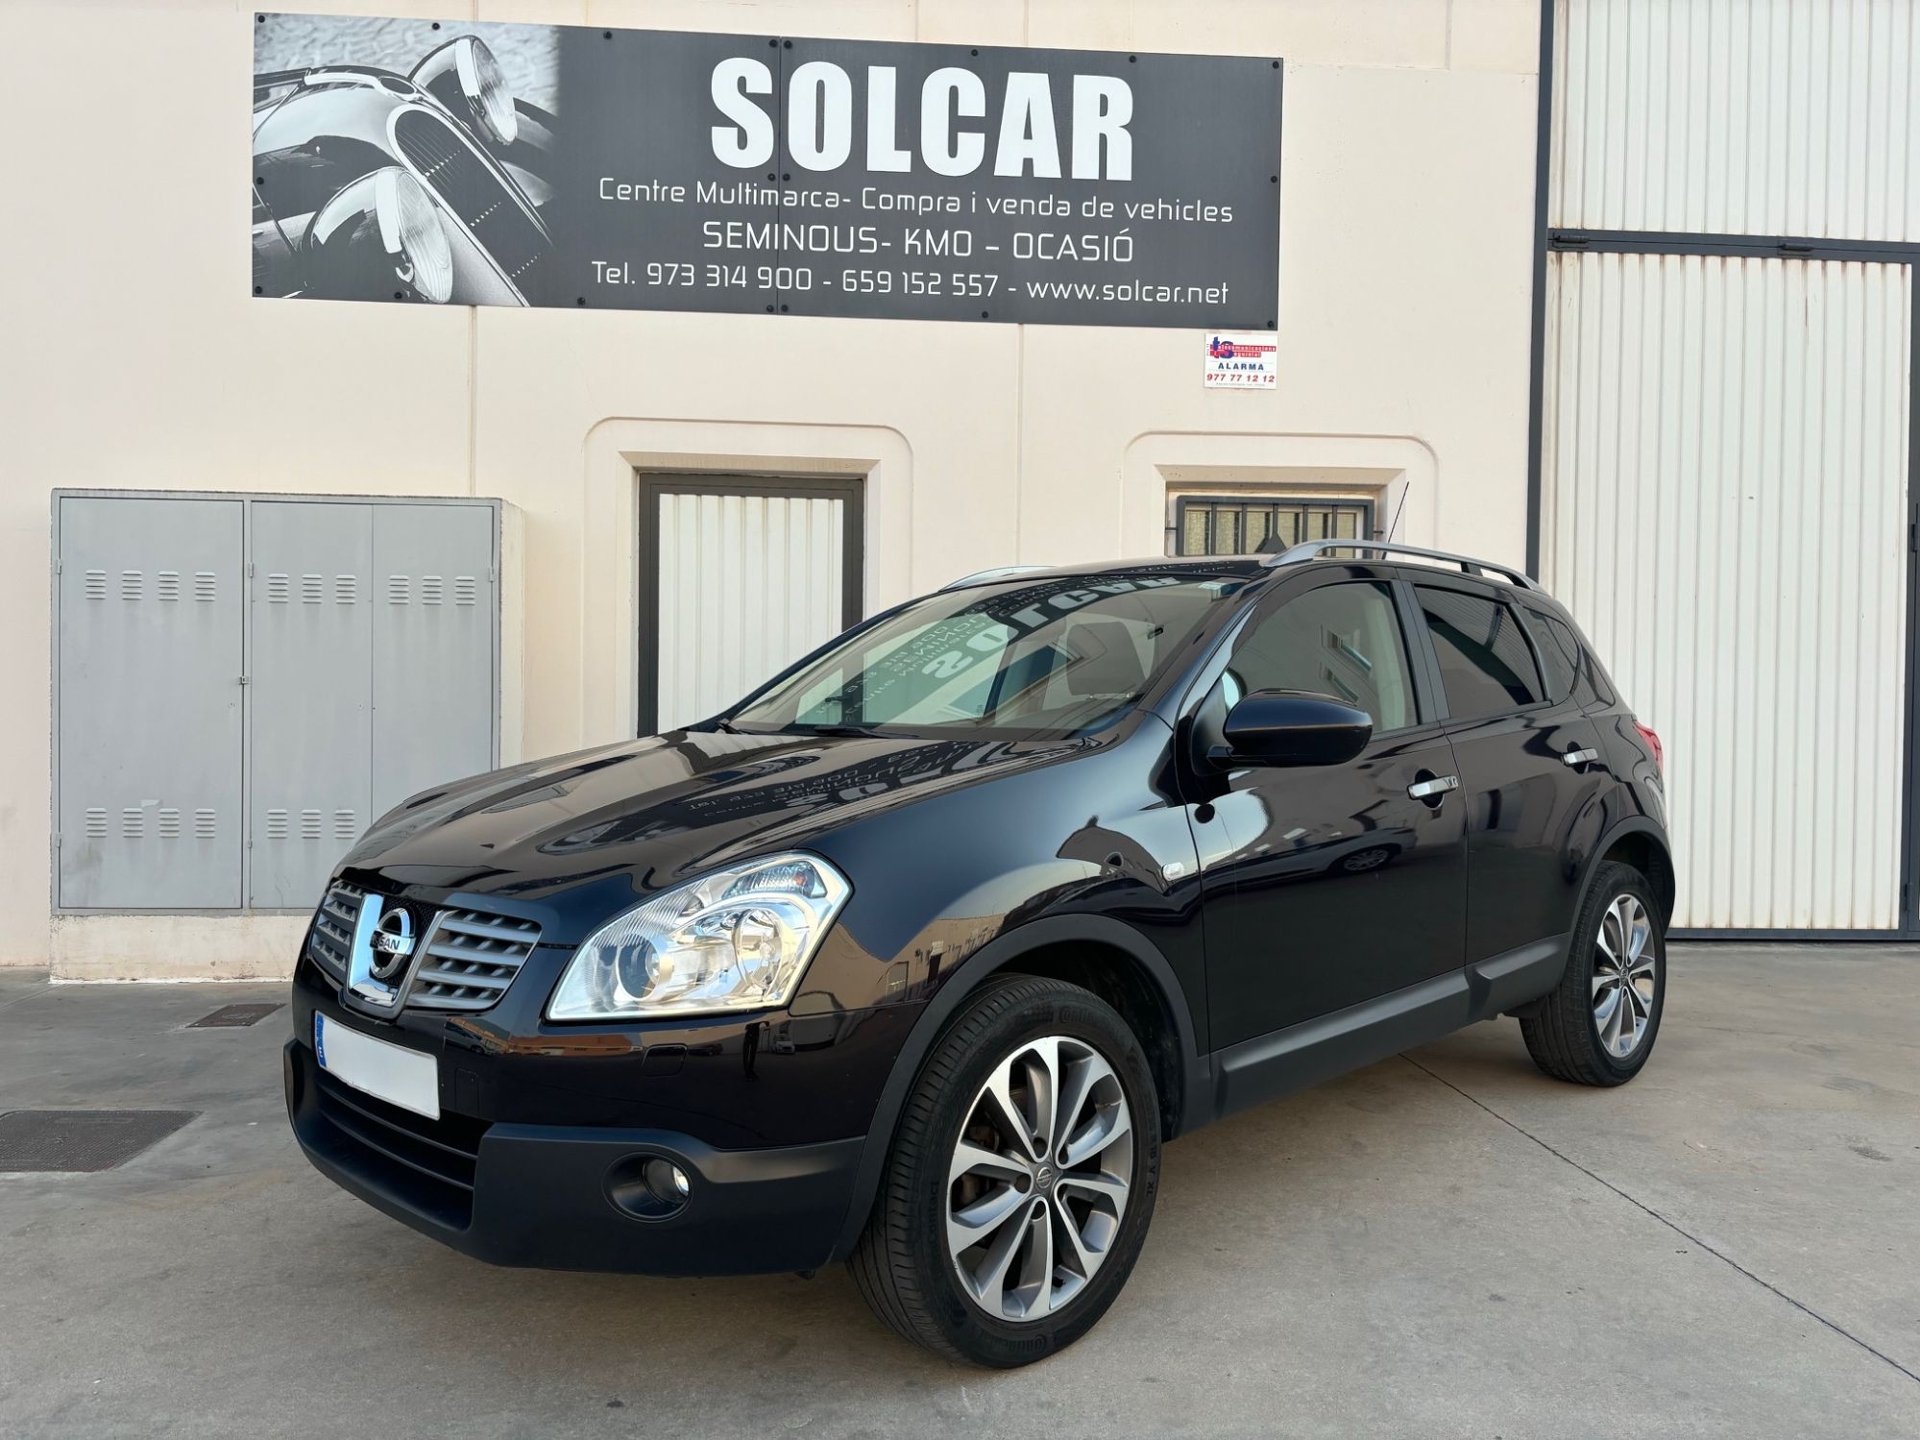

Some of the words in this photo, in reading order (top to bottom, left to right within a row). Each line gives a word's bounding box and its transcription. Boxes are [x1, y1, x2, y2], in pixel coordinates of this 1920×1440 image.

[711, 57, 1134, 182] SOLCAR
[599, 177, 686, 203] Centre
[696, 180, 851, 208] Multimarca-
[862, 187, 961, 216] Compra
[971, 192, 976, 213] i
[986, 194, 1071, 217] venda
[1081, 195, 1114, 218] de
[1124, 197, 1233, 223] vehicles
[703, 221, 891, 254] SEMINOUS-
[1013, 228, 1133, 262] OCASIÓ
[591, 260, 636, 285] Tel.
[647, 262, 695, 286] 973
[706, 264, 747, 288] 314
[757, 266, 812, 291] 900
[842, 269, 892, 293] 659
[902, 271, 942, 295] 152
[952, 273, 999, 298] 557
[1026, 279, 1229, 304] www.solcar.net
[1206, 373, 1226, 381] 977
[1230, 374, 1242, 382] 77
[1246, 374, 1259, 382] 12
[1263, 375, 1275, 383] 12
[1218, 362, 1264, 371] ALARMA
